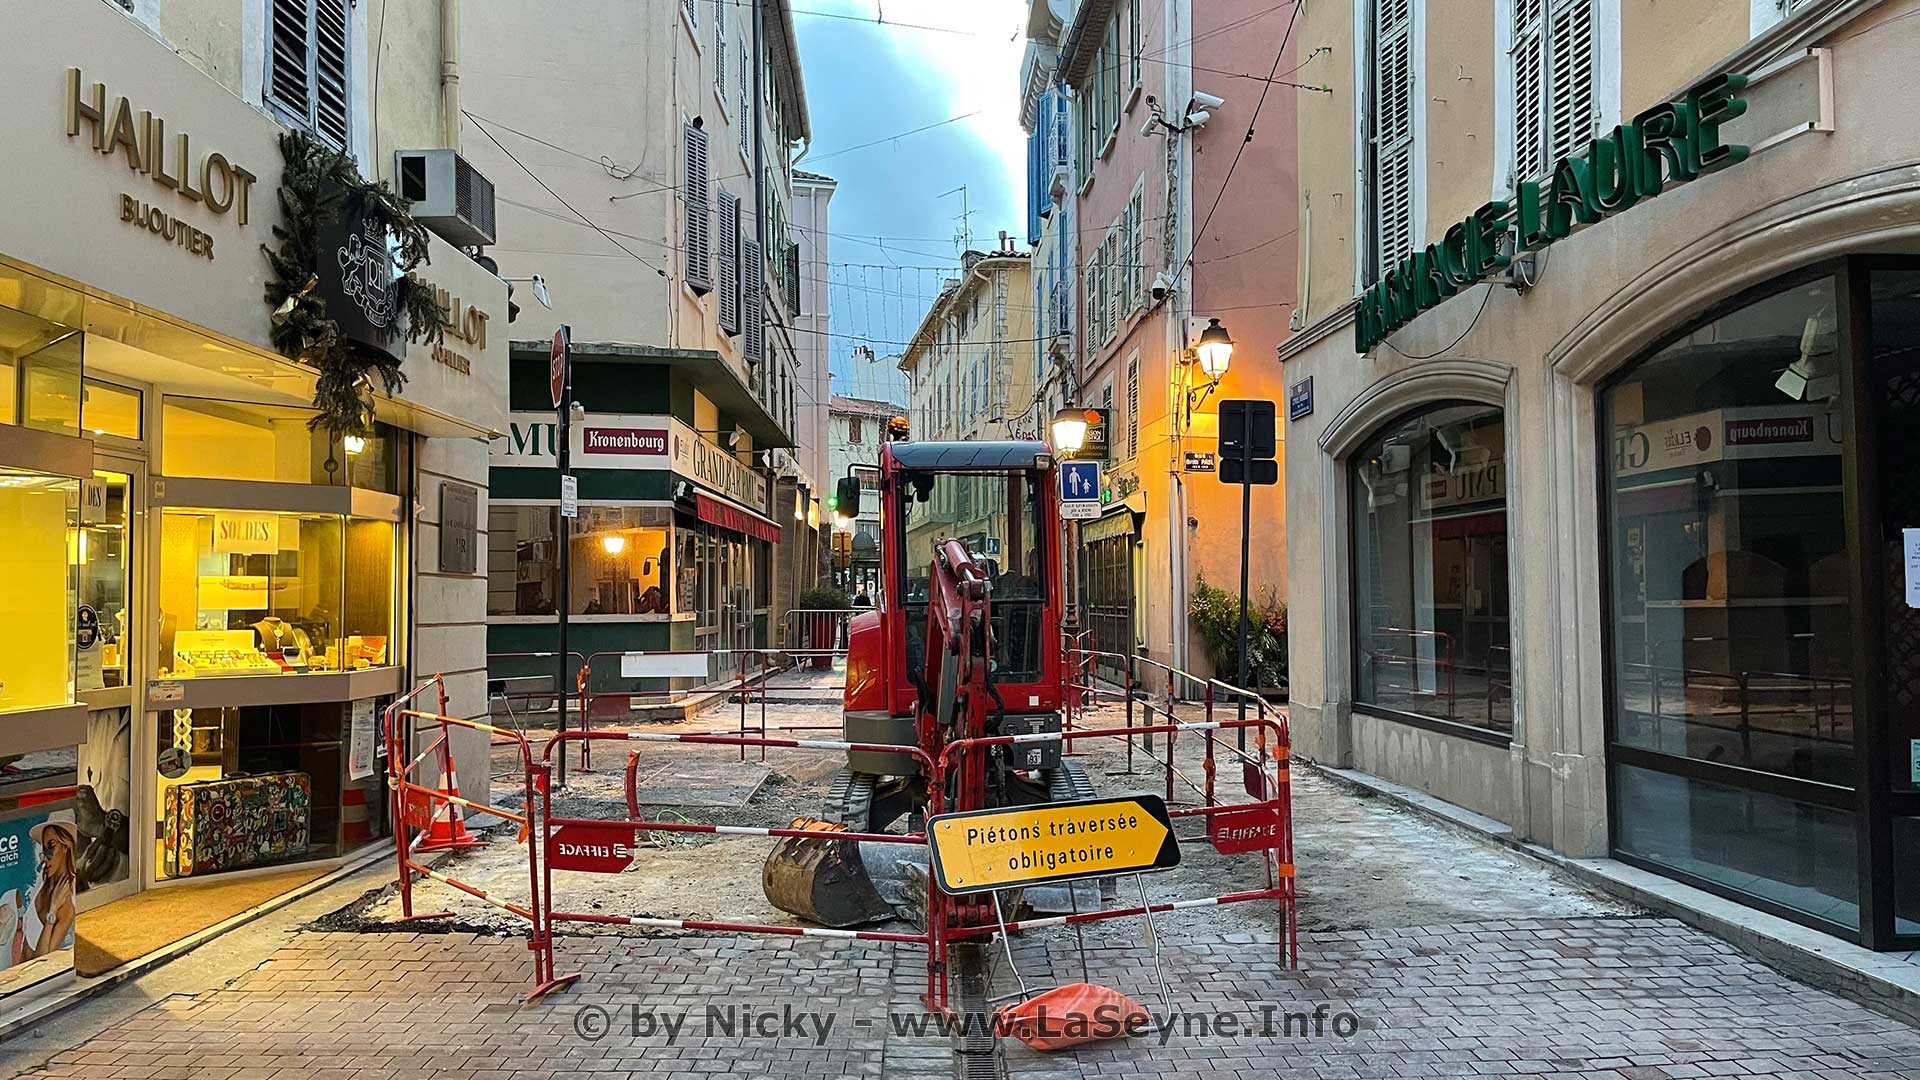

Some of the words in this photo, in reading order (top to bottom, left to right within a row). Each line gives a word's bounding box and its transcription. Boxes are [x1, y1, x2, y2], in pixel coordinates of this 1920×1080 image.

[67, 67, 257, 226] HAILLOT
[1516, 73, 1750, 250] LAURE
[120, 192, 215, 260] BIJOUTIER
[409, 271, 490, 351] ILLOT
[552, 353, 564, 380] STOP
[589, 430, 665, 452] Kronenbourg
[693, 438, 725, 488] GRAND
[726, 459, 740, 496] BAR
[220, 519, 269, 542] SOLDES
[967, 825, 1041, 846] Piétons
[1049, 813, 1138, 836] traversée
[0, 852, 19, 863] atch
[1009, 844, 1114, 870] obligatoire
